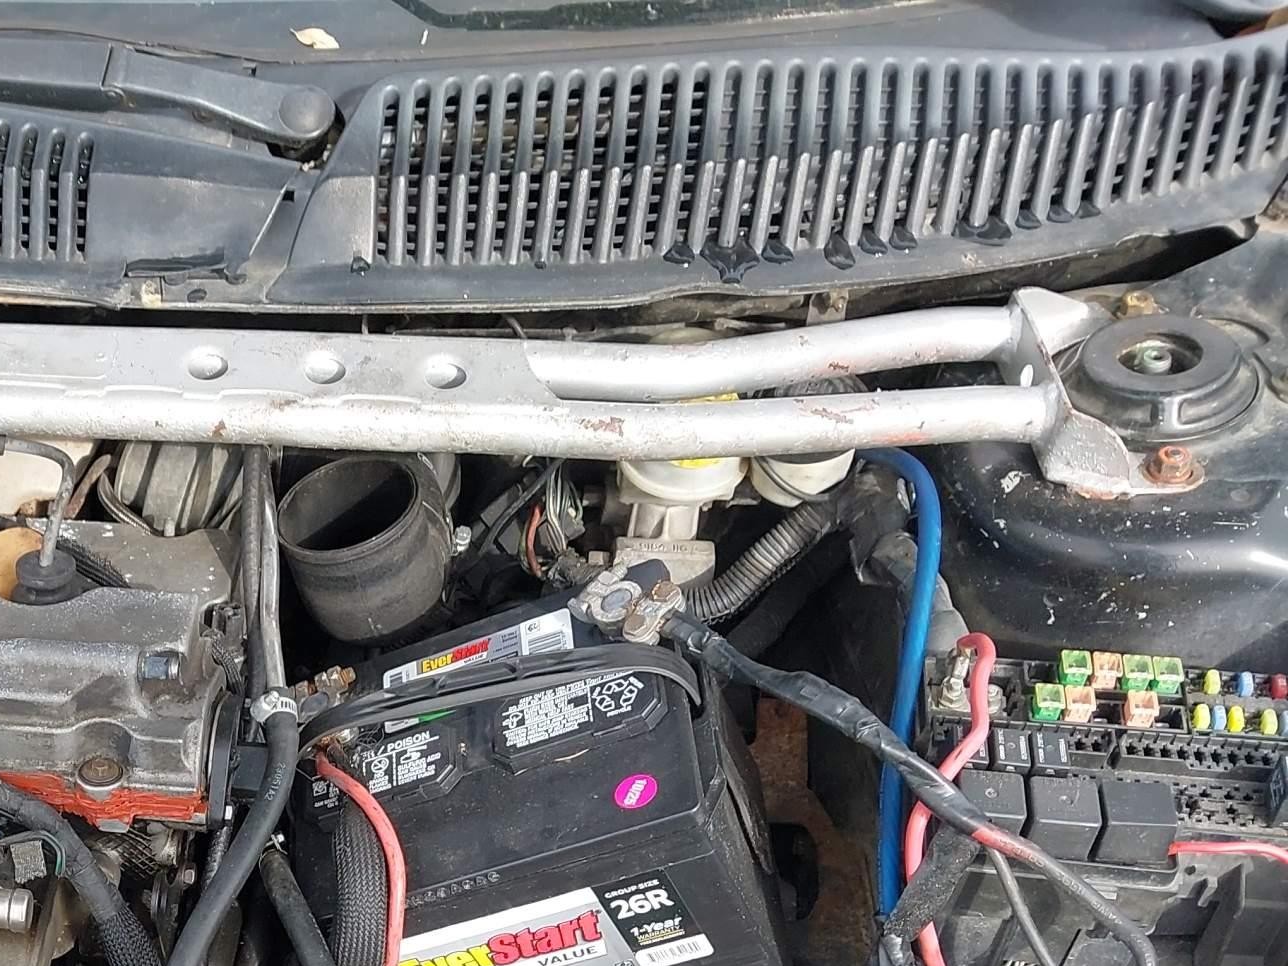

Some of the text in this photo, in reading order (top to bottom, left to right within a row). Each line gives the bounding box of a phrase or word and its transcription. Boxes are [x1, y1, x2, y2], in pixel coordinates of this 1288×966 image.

[421, 637, 491, 674] EverStart
[386, 731, 431, 753] POISON
[604, 879, 660, 899] GROUP SIZE
[609, 888, 675, 920] 26R
[630, 916, 683, 937] 1-Year
[636, 925, 681, 941] WARRANTY
